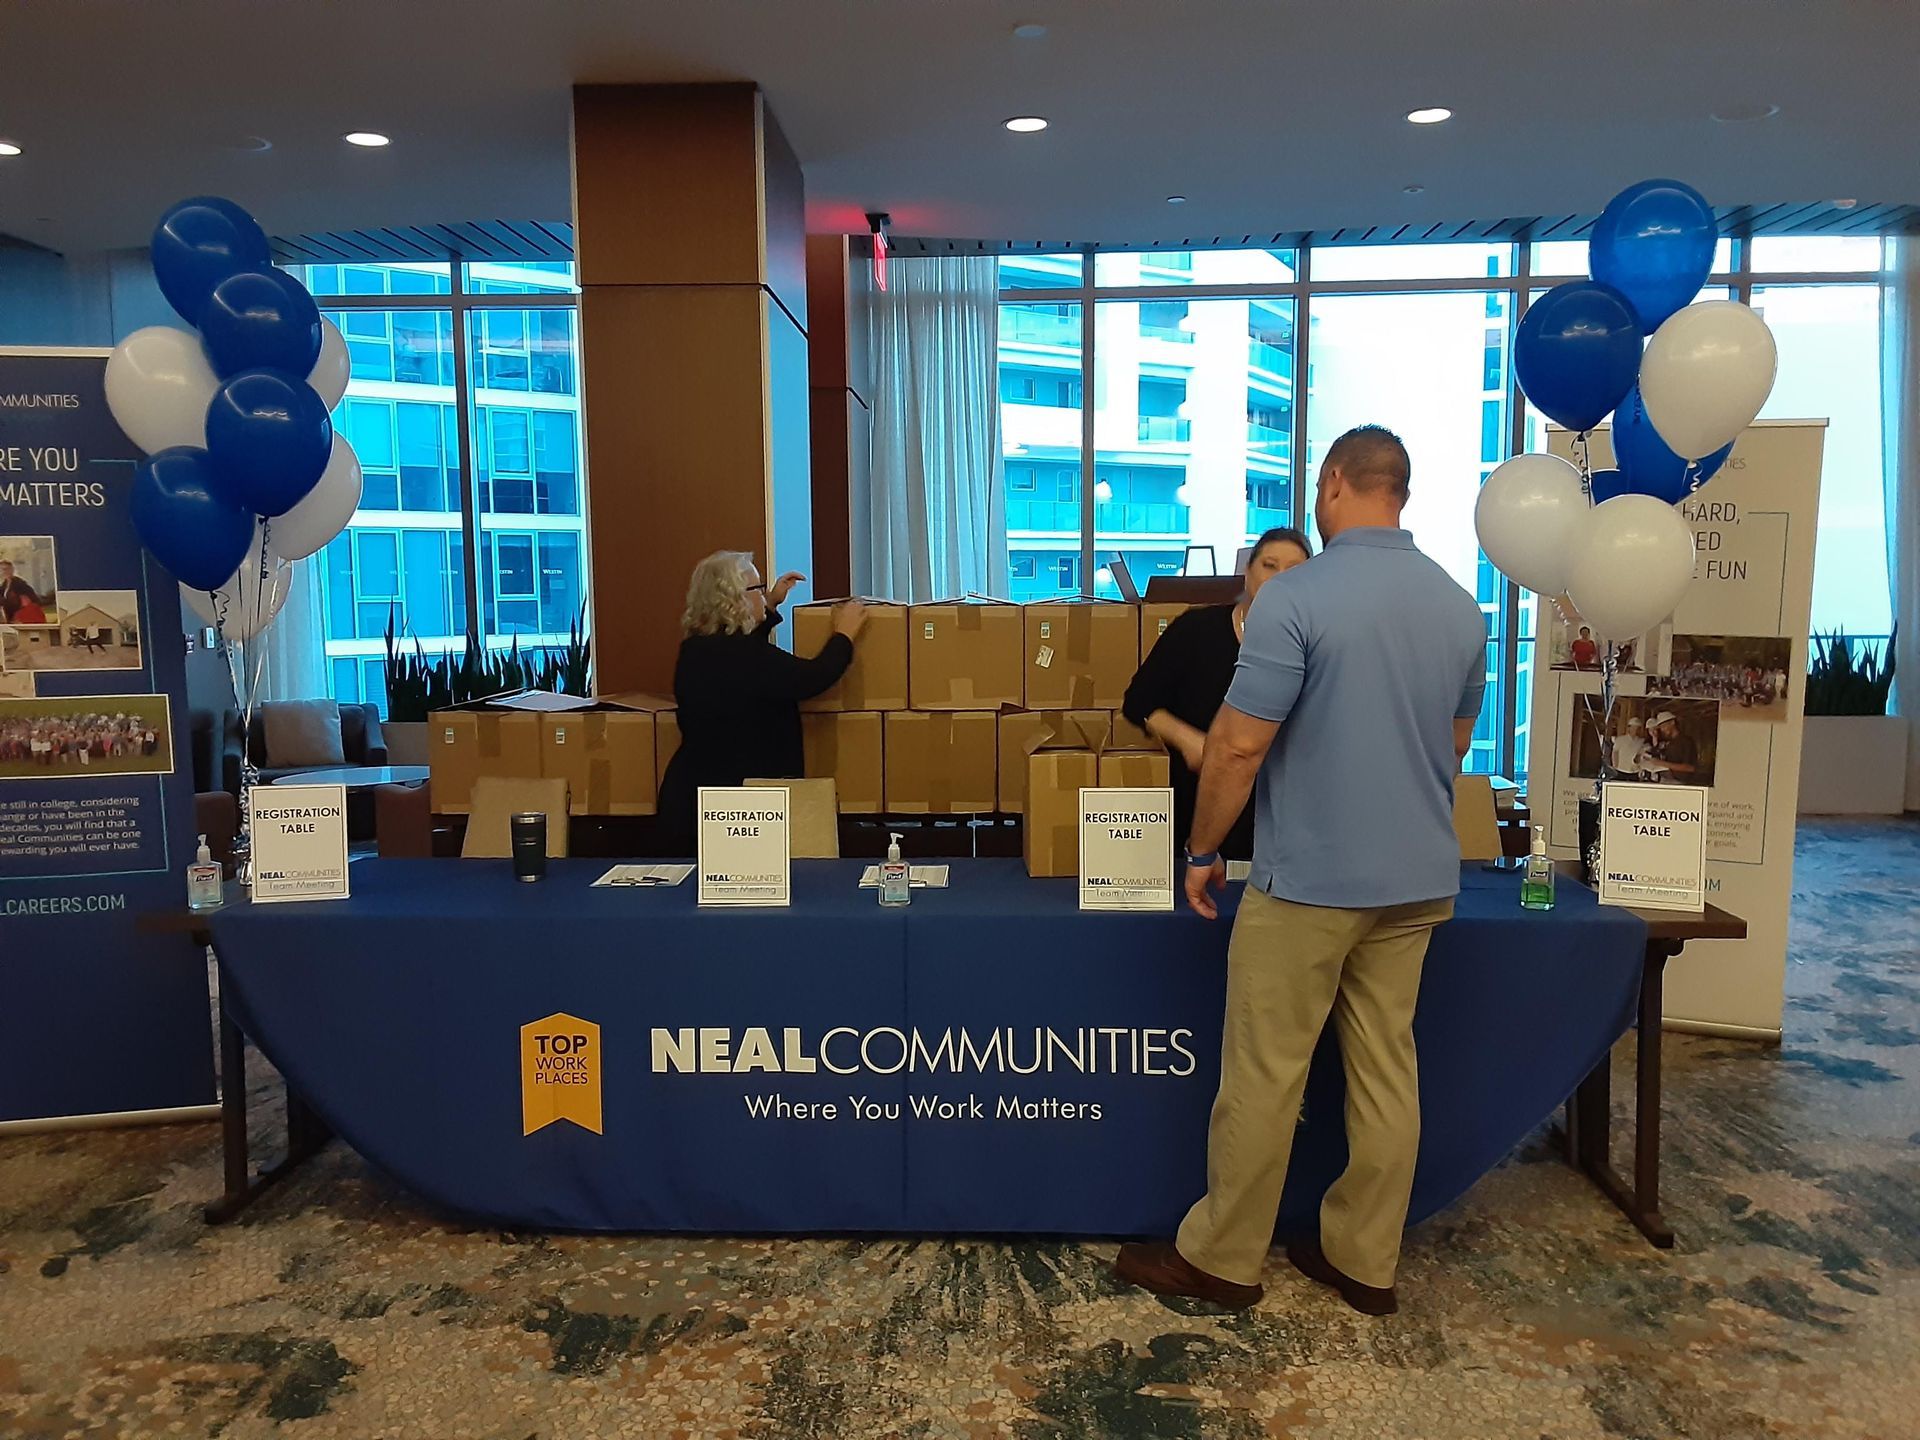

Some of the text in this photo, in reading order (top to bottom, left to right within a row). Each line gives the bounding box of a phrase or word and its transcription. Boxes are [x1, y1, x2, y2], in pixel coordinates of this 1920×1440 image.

[28, 447, 77, 472] YOU
[0, 482, 105, 506] MATTERS
[1682, 502, 1741, 525] HARD,
[1707, 560, 1747, 580] FUN
[80, 797, 139, 807] considering
[67, 811, 93, 819] been
[96, 809, 106, 817] in
[107, 809, 125, 817] the
[255, 807, 340, 820] REGISTRATION
[704, 811, 784, 821] REGISTRATION
[1085, 813, 1168, 823] REGISTRATION
[1607, 807, 1700, 822] REGISTRATION
[280, 823, 315, 834] TABLE
[727, 827, 760, 837] TABLE
[1109, 829, 1142, 839] TABLE
[1633, 825, 1671, 837] TABLE
[17, 833, 84, 844] Communities
[86, 833, 104, 841] can
[106, 830, 120, 840] be
[121, 830, 142, 839] one
[534, 1034, 588, 1055] TOP
[535, 1057, 587, 1070] WORK
[535, 1073, 588, 1084] PLACES
[744, 1092, 1103, 1120] Where You Work Matters
